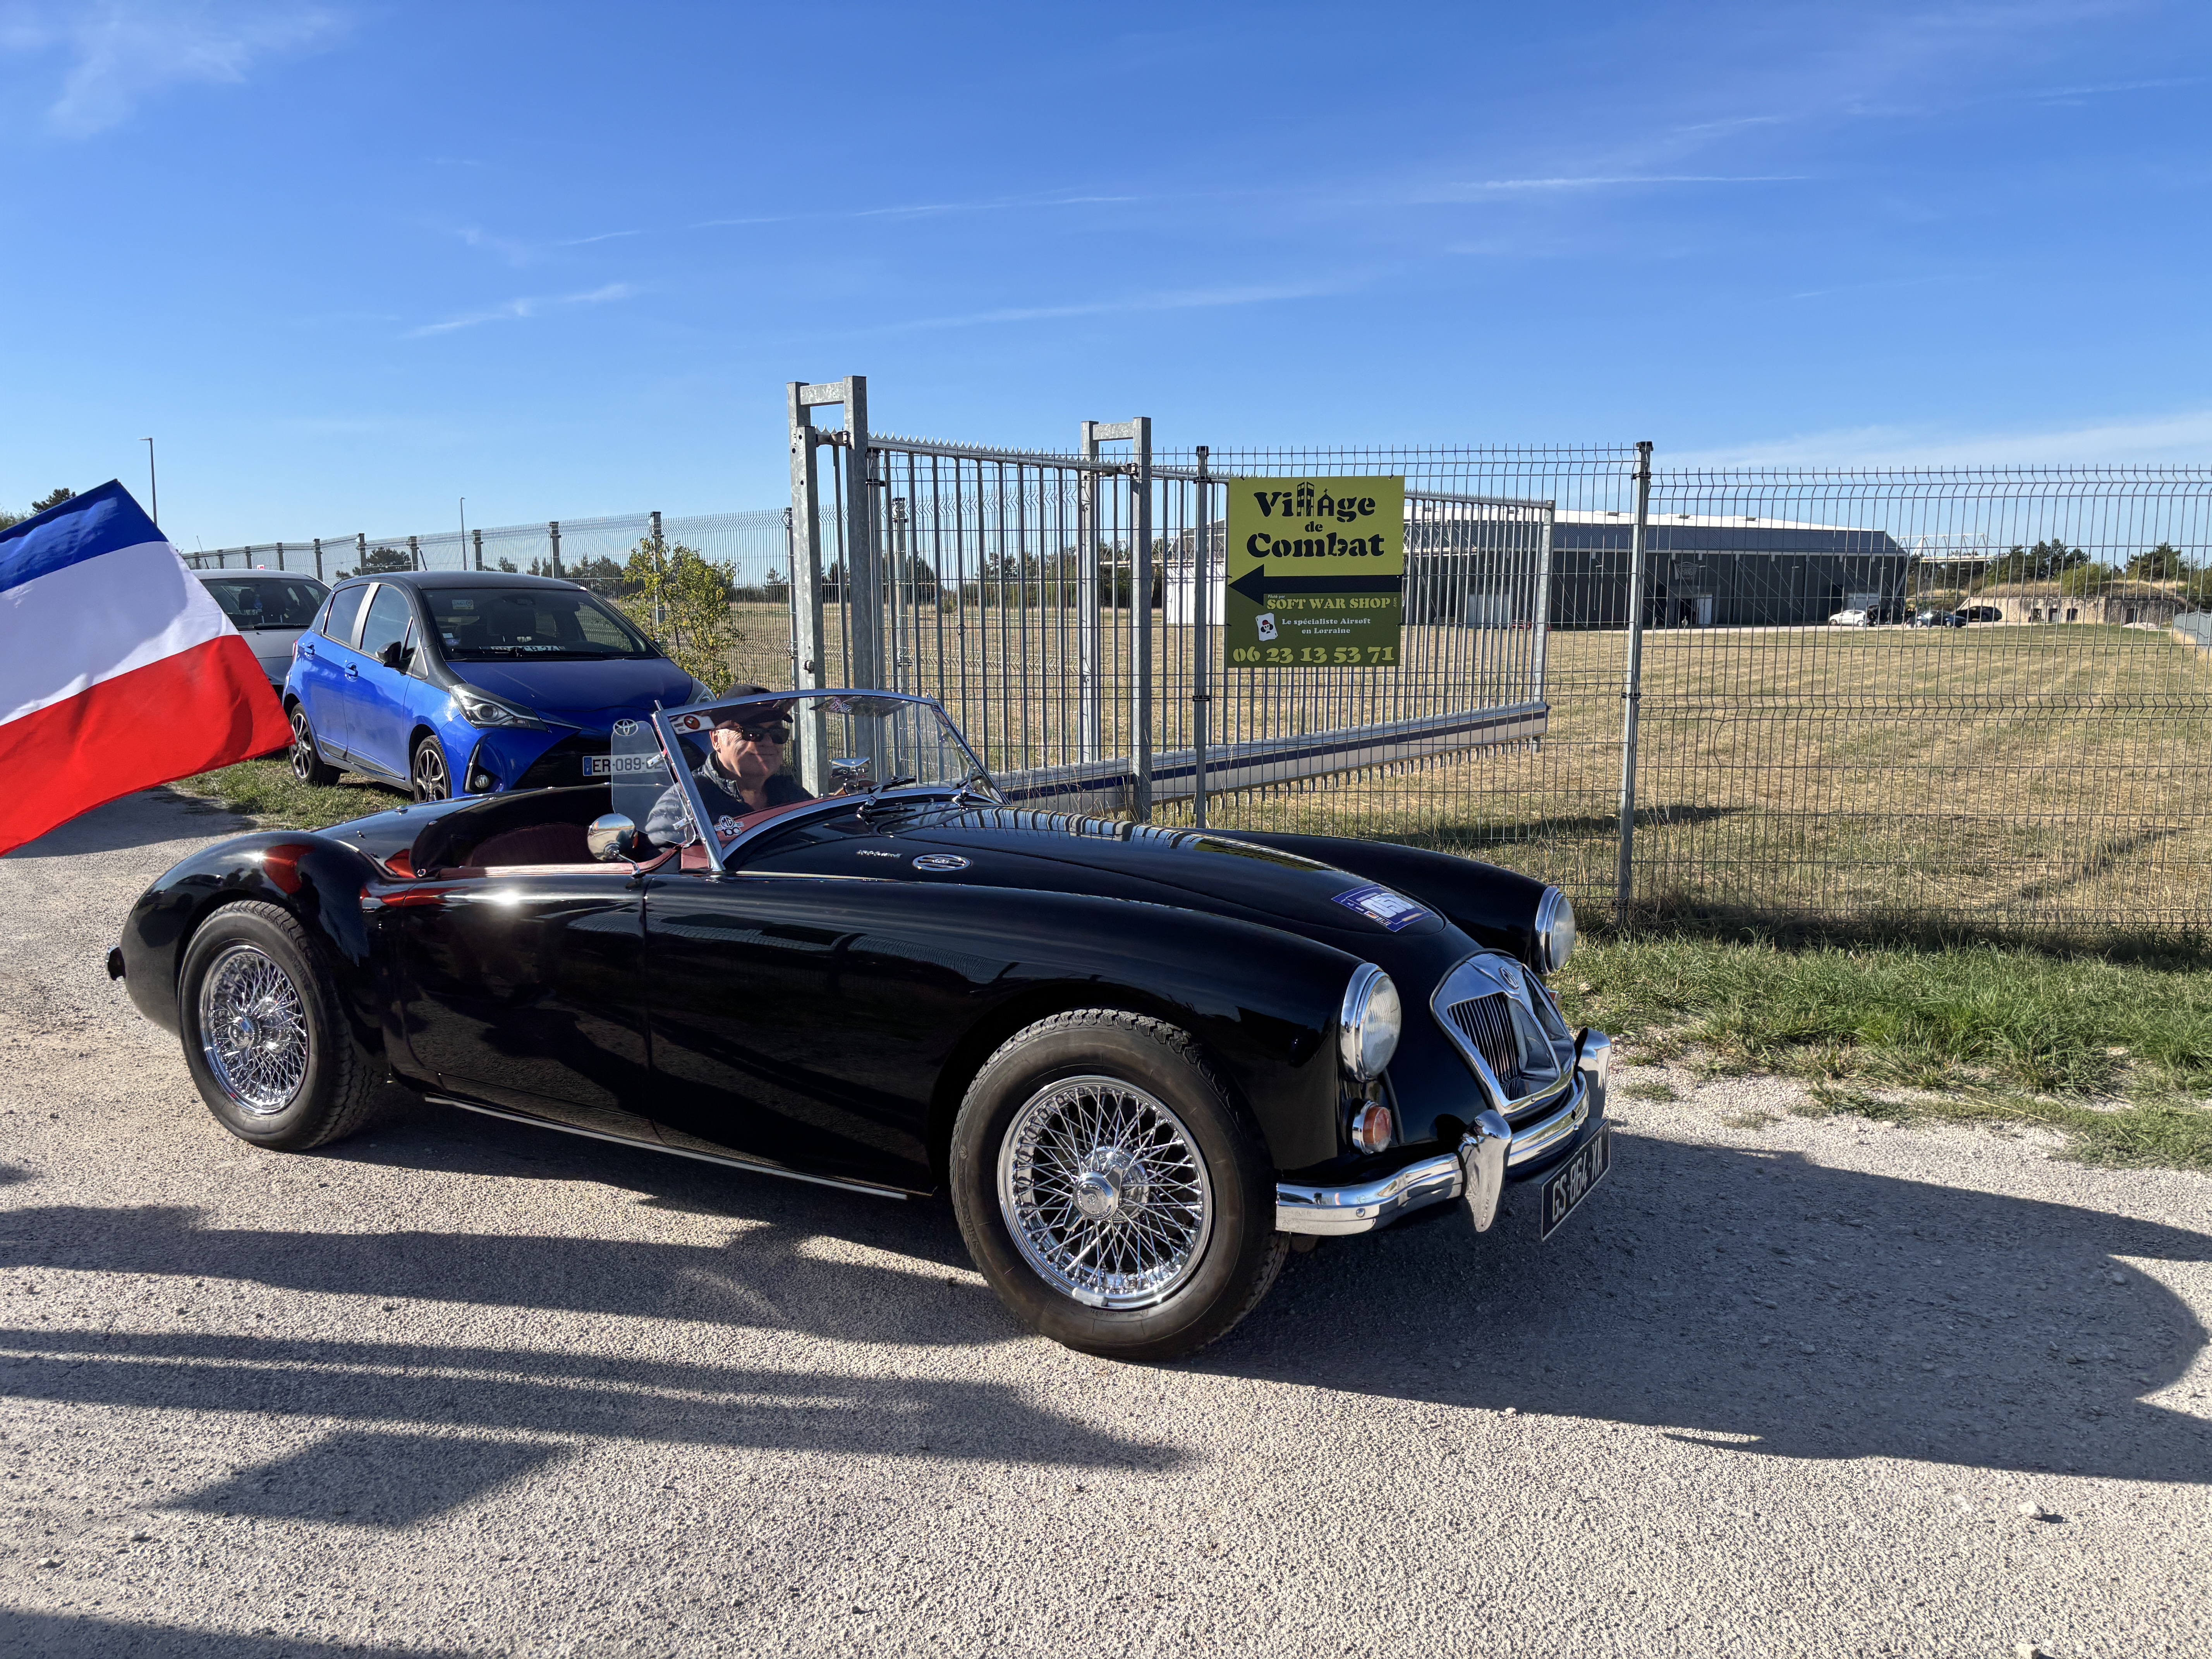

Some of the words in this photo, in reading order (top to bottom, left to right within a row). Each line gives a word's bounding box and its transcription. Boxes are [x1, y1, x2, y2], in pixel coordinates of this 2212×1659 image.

[1304, 521, 1323, 532] de
[1247, 532, 1384, 558] Combat
[1267, 599, 1306, 610] SOFT
[1309, 598, 1346, 609] WAR
[1349, 598, 1391, 609] SHOP
[1233, 646, 1261, 662] 06
[1266, 647, 1294, 664] 23
[1300, 647, 1327, 663] 13
[1334, 647, 1361, 663] 53
[1367, 647, 1394, 663] 71
[721, 816, 733, 827] MG
[721, 827, 740, 836] 100
